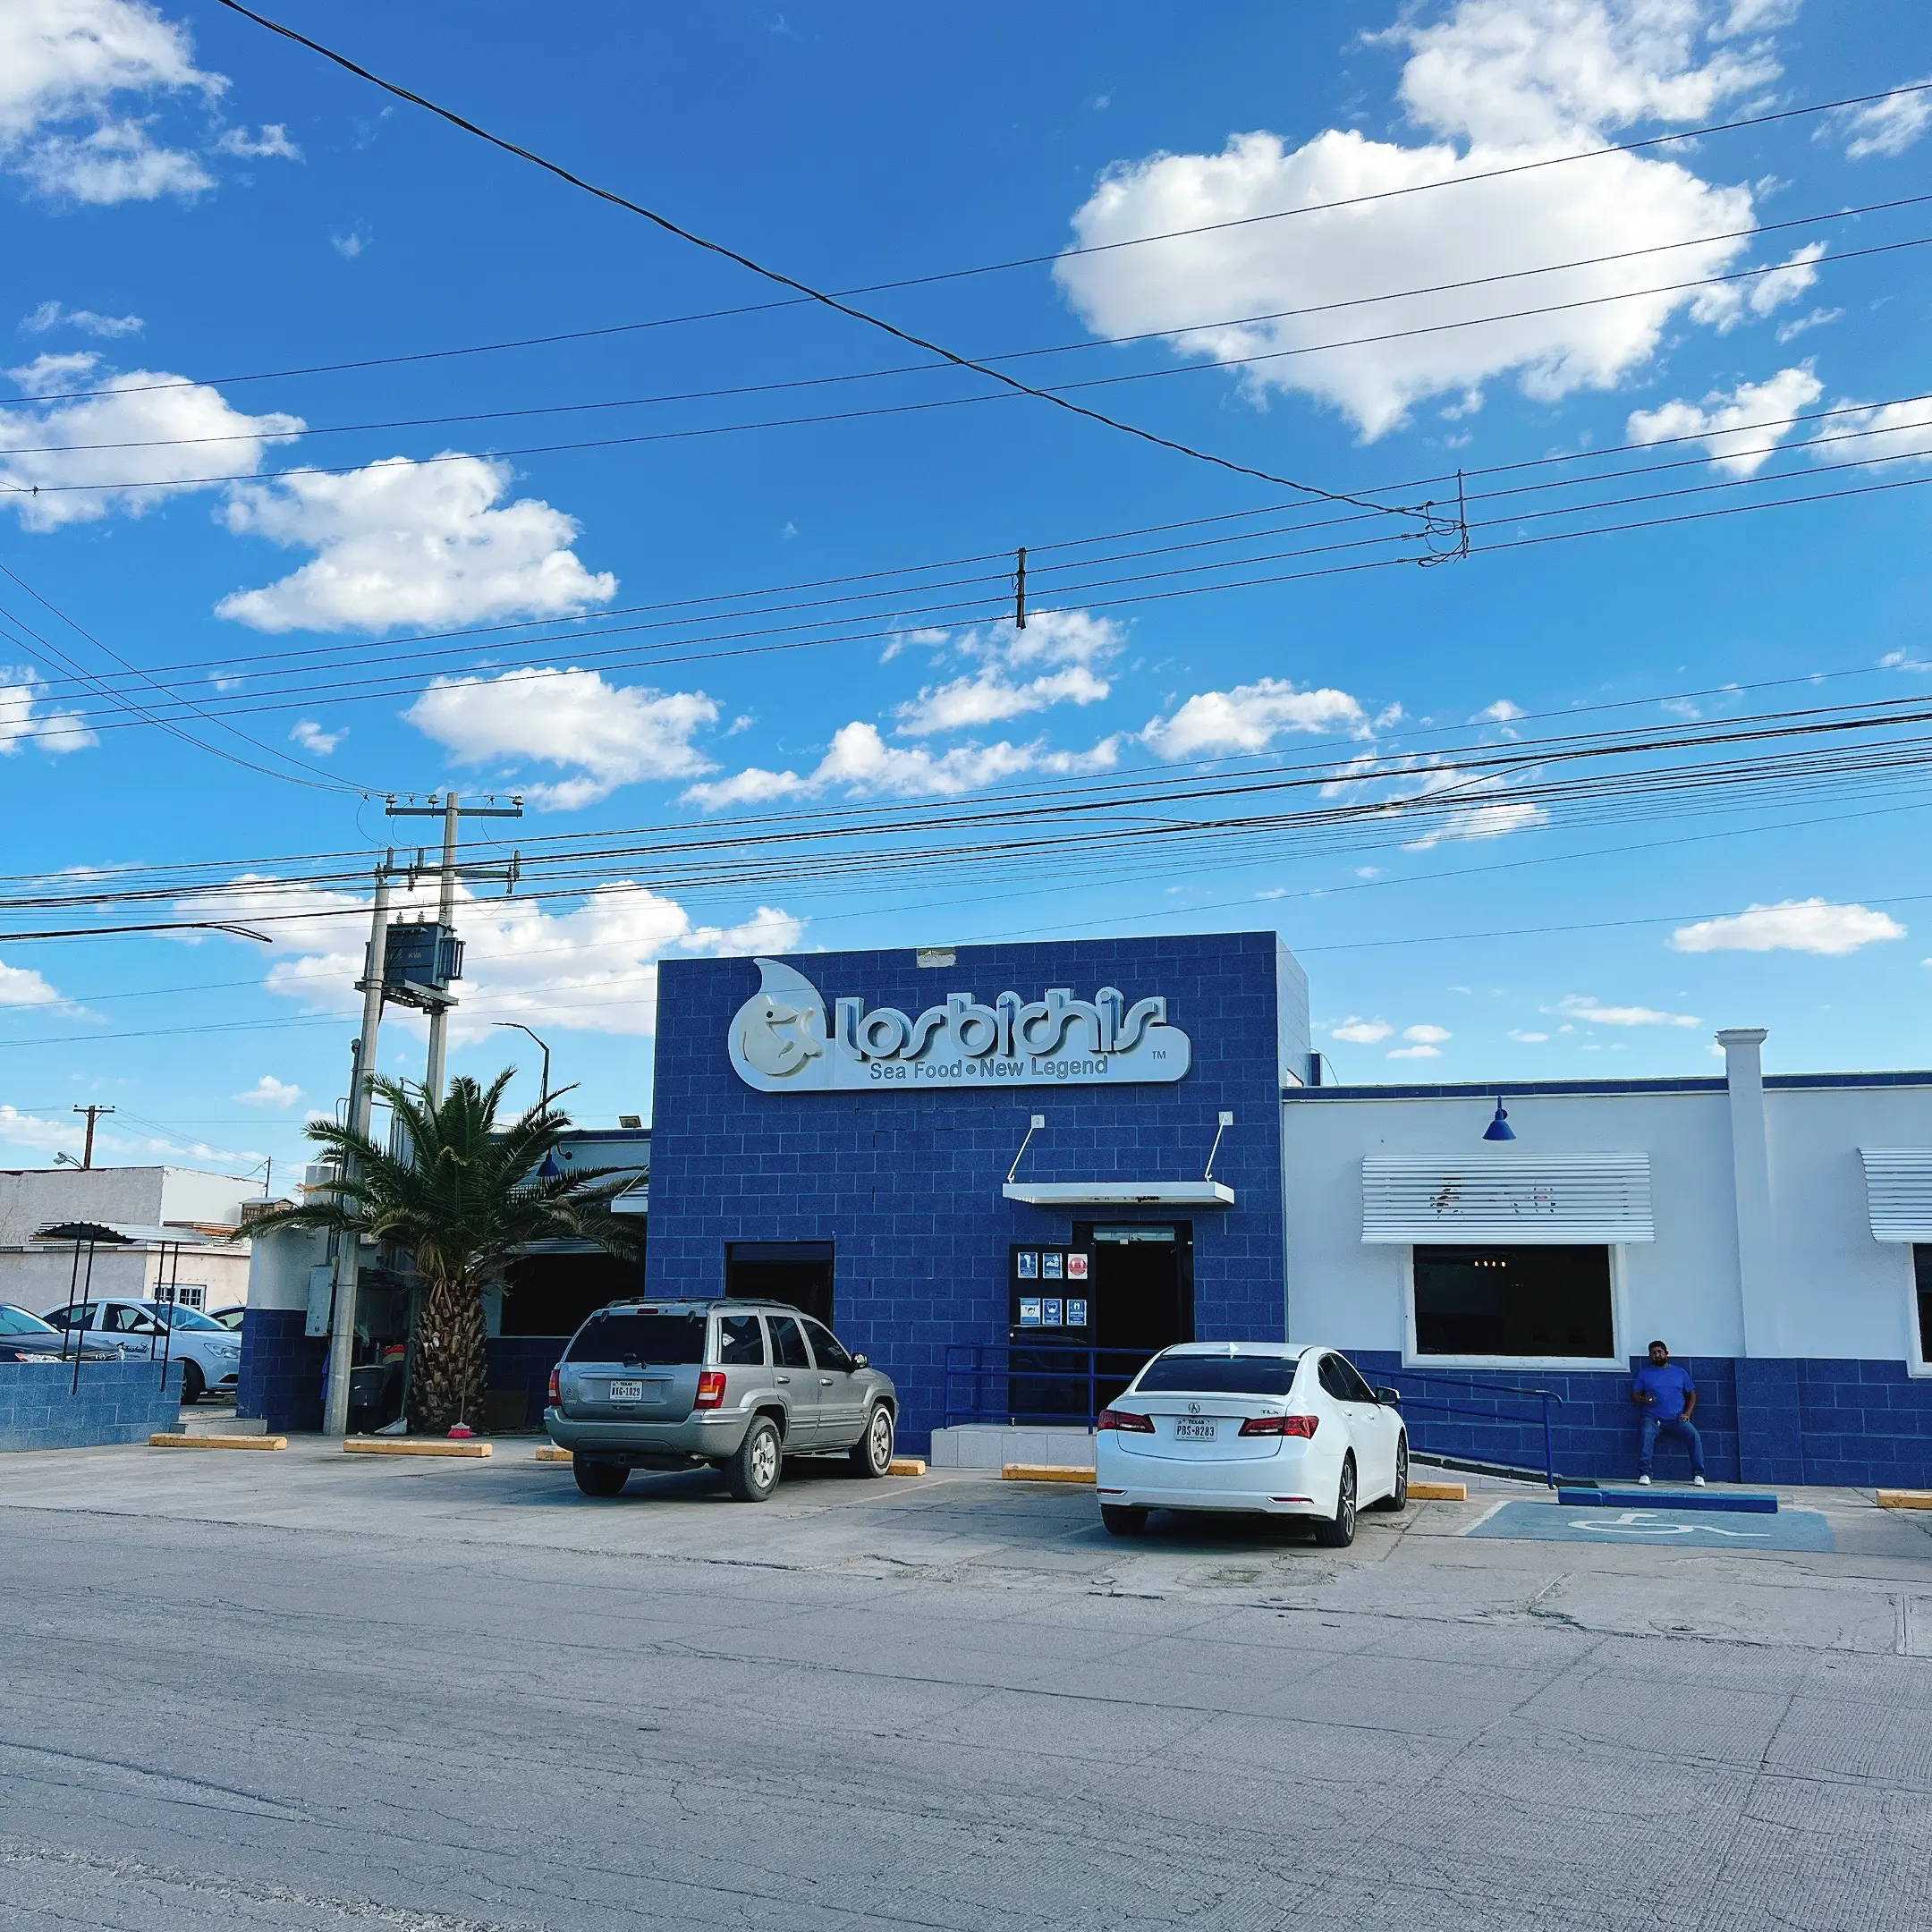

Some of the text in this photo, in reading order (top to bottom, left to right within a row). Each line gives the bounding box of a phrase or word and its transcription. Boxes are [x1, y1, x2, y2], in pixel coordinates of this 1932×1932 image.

[869, 1055, 1108, 1080] Sea Food New Legend
[1176, 1425, 1215, 1436] PBS-8283
